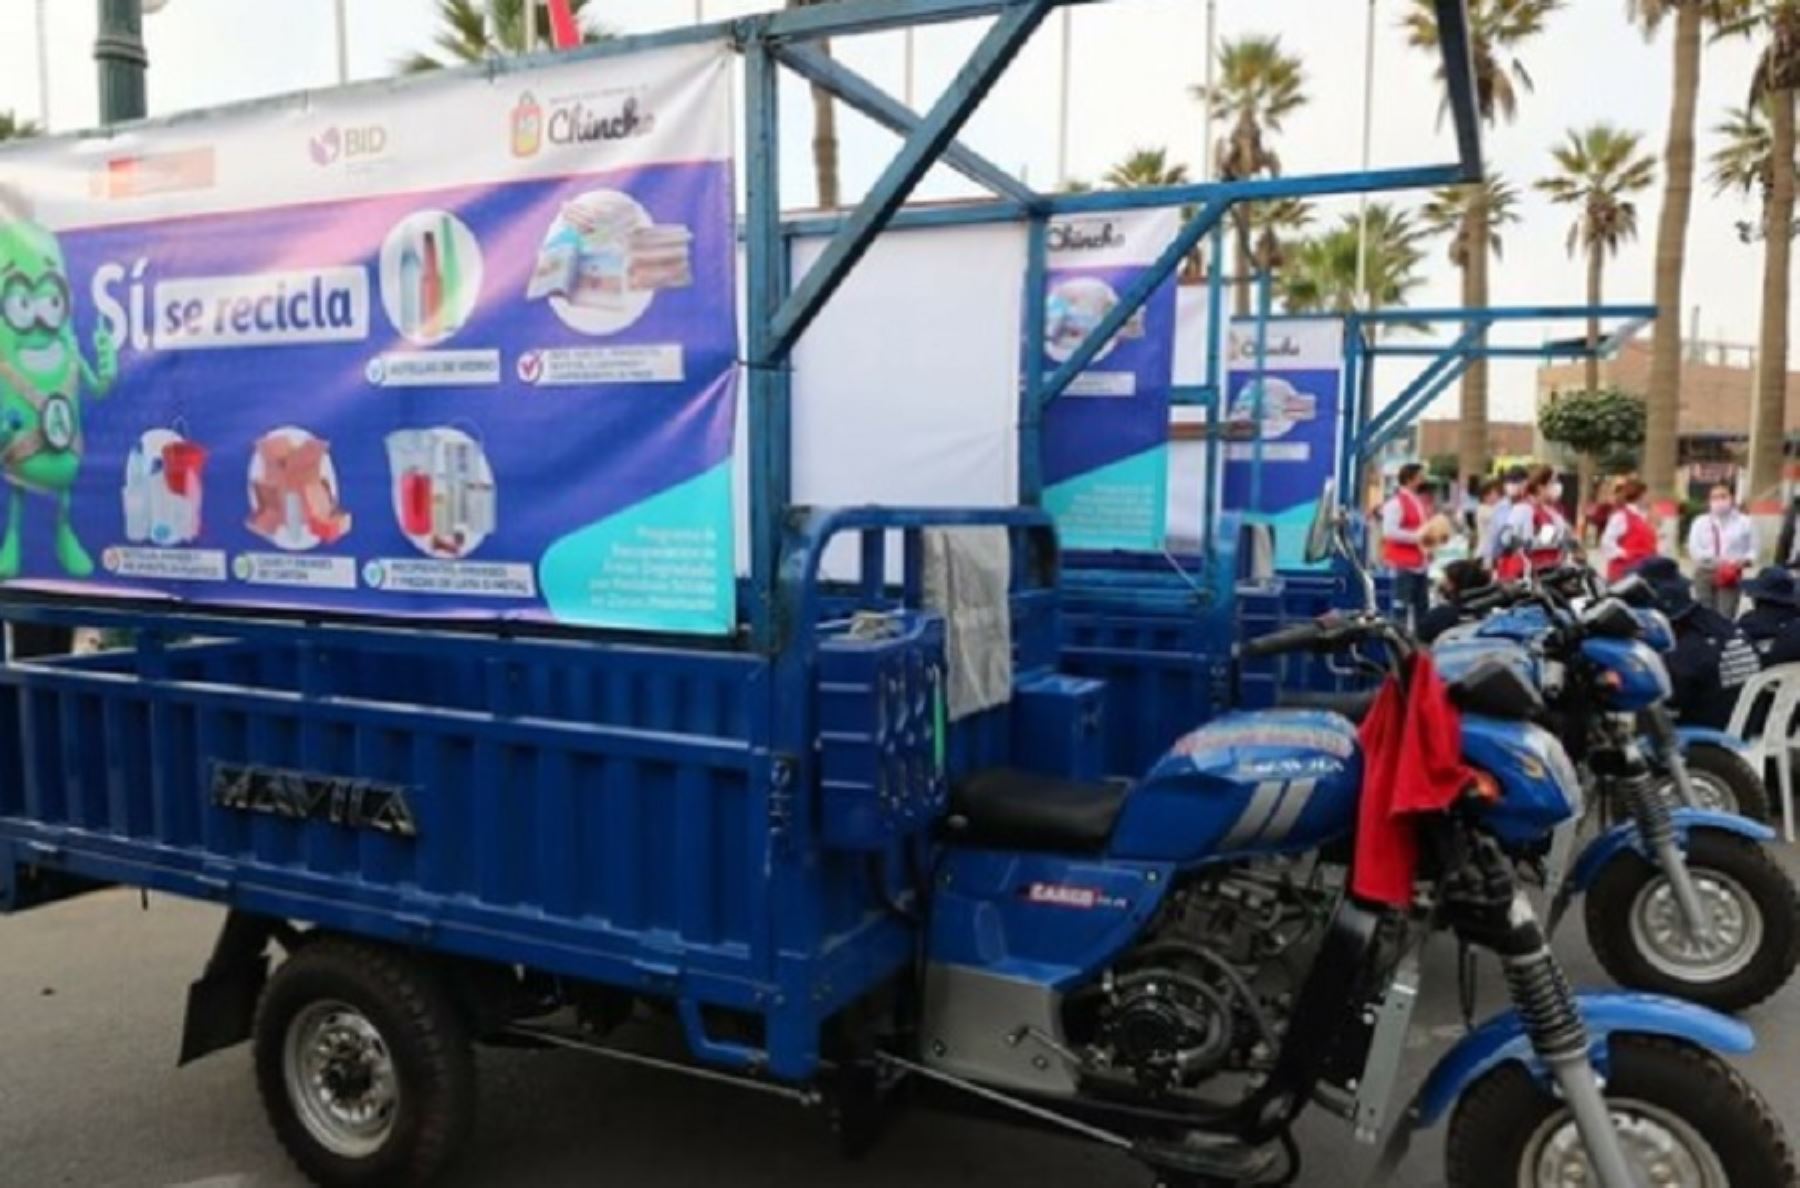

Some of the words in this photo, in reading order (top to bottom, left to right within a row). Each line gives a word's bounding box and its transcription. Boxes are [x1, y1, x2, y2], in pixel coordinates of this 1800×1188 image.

[344, 126, 387, 157] BID
[92, 258, 149, 351] Sí
[165, 300, 203, 335] se
[213, 276, 354, 336] recicla
